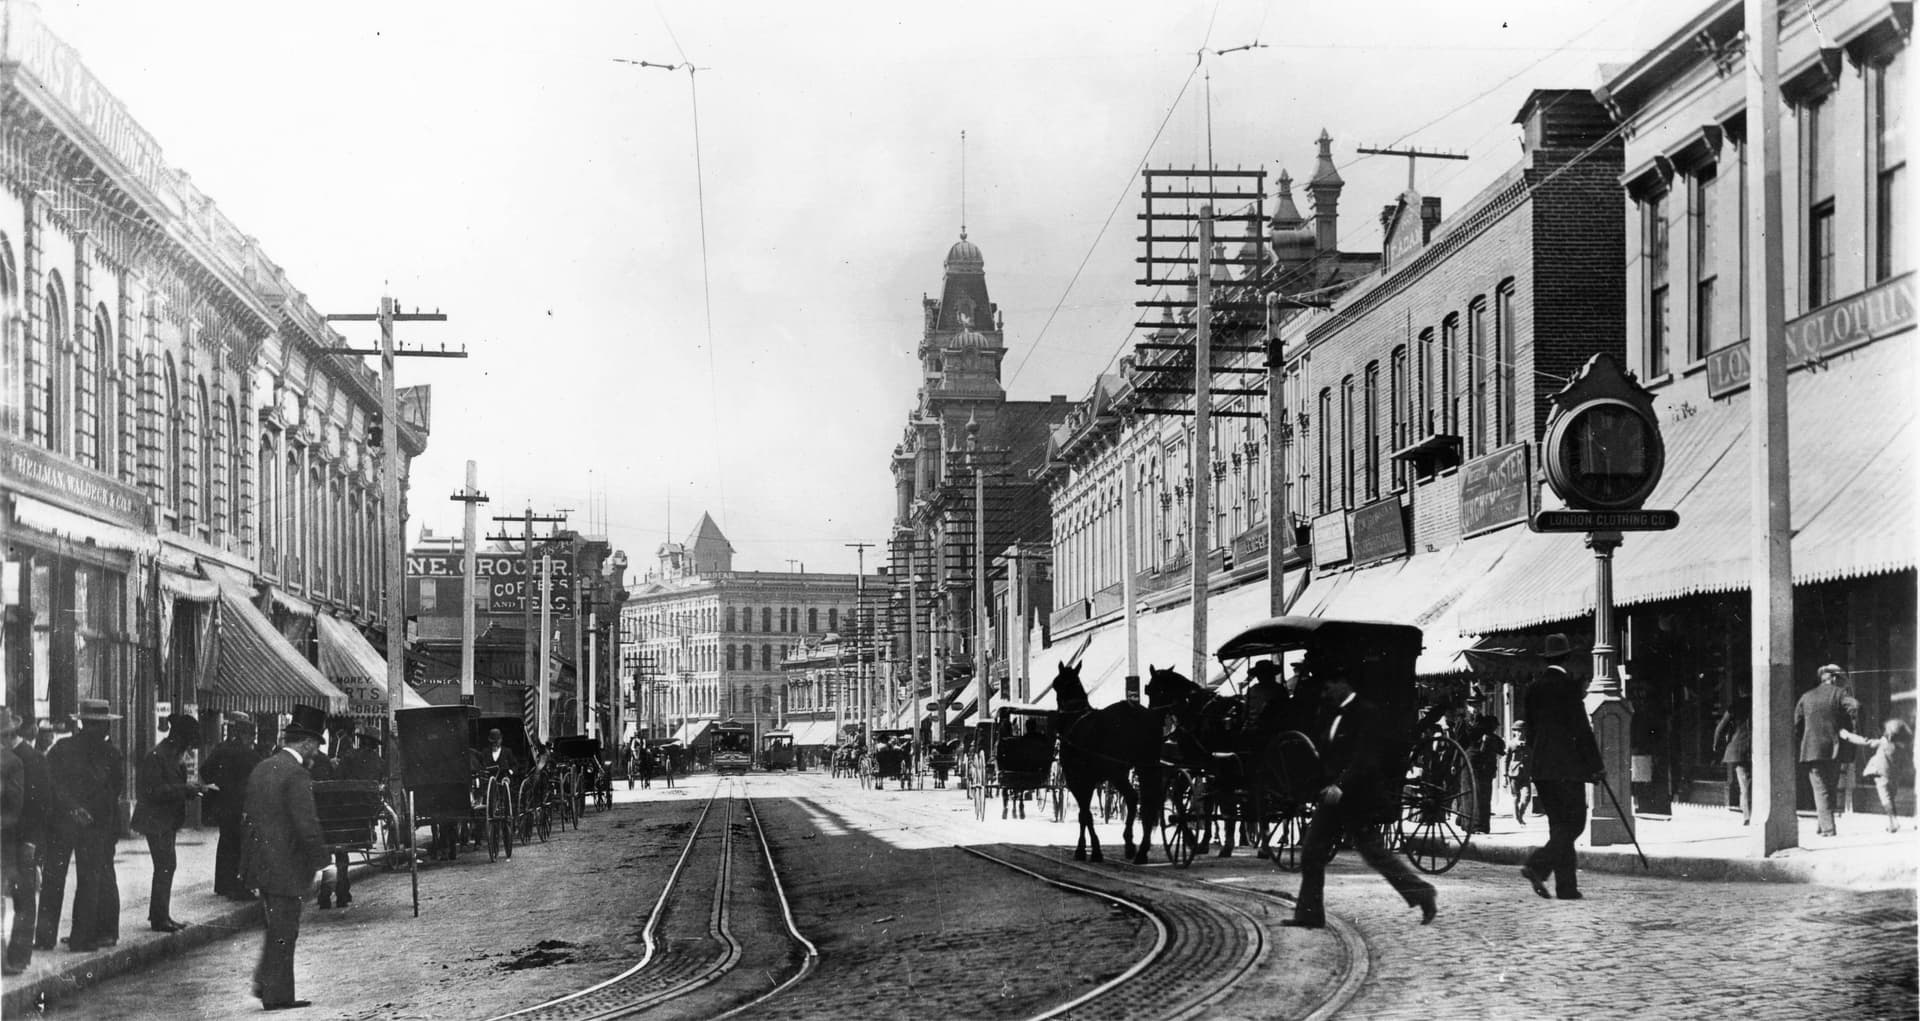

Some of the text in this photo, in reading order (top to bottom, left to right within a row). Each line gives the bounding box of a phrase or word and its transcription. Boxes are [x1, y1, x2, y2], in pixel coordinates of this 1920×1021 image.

[1715, 326, 1798, 386] LONN
[1549, 513, 1592, 527] LONDON
[1596, 513, 1648, 527] CLOTHING
[493, 601, 516, 609] AND
